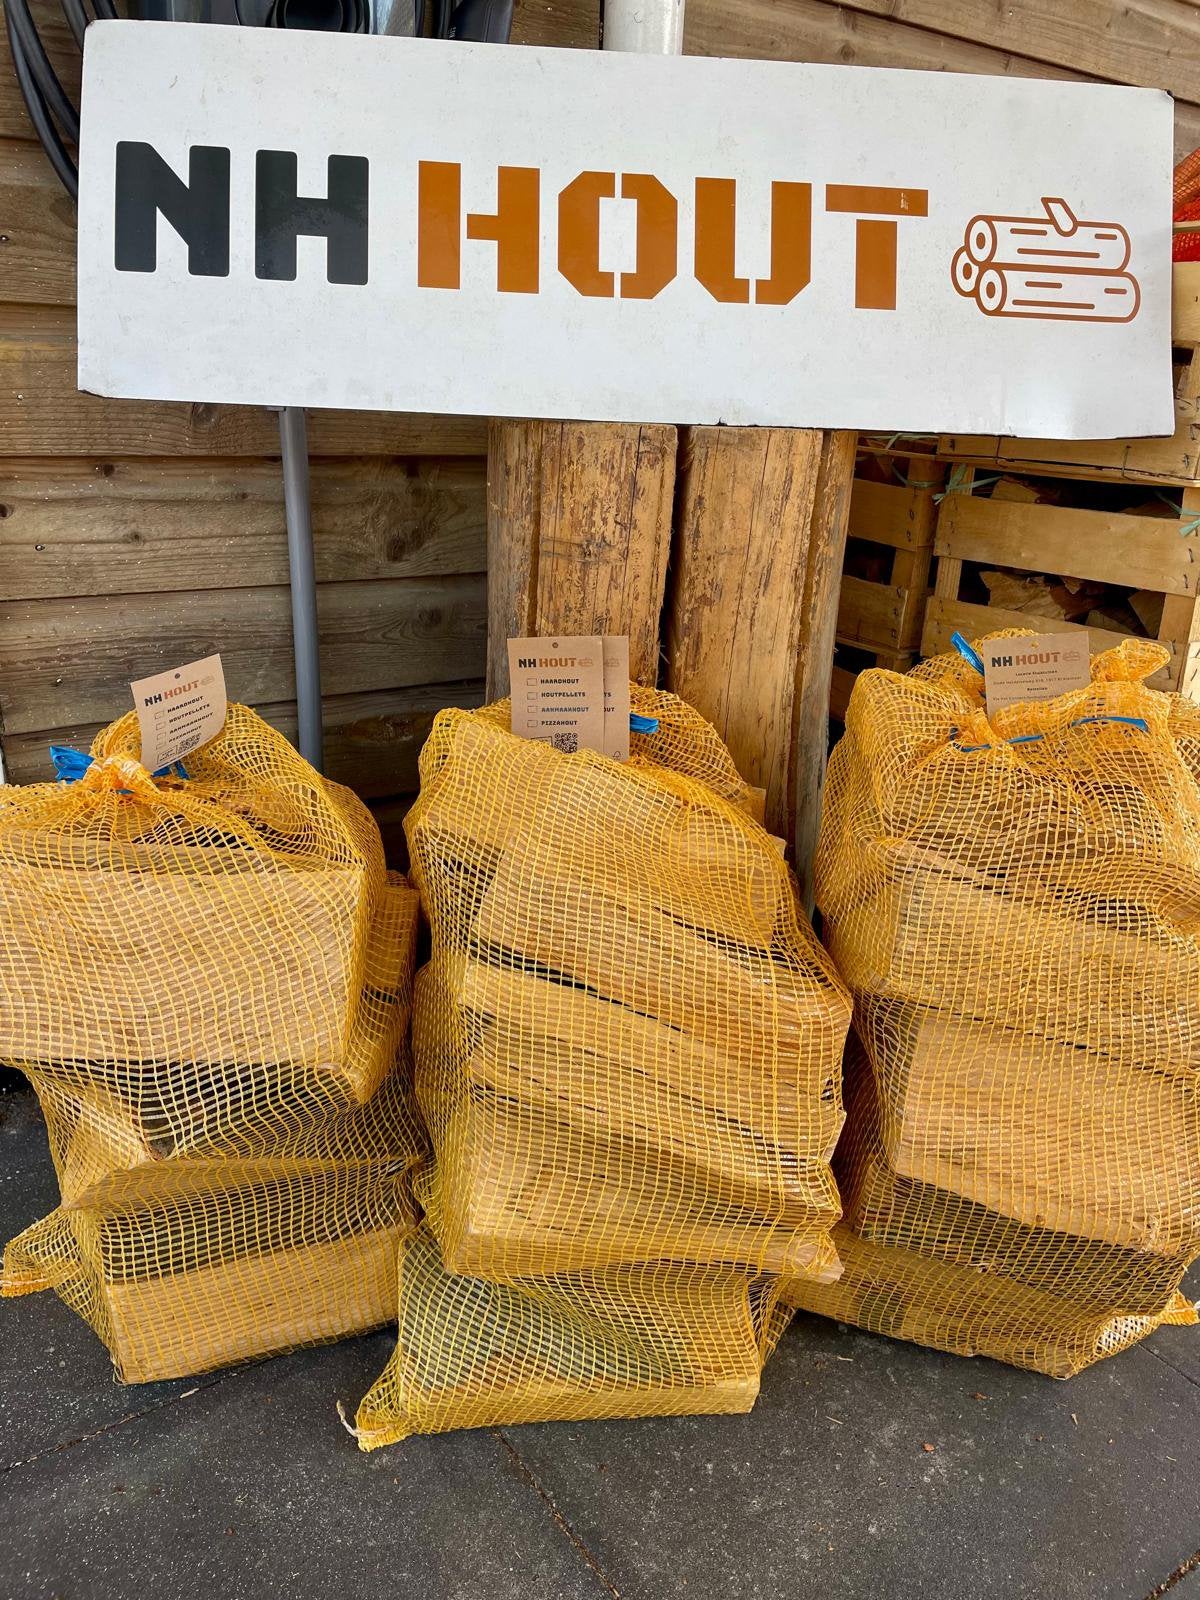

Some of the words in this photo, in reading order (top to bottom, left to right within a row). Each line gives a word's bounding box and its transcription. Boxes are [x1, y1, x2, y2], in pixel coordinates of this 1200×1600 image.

[115, 141, 369, 285] NH
[417, 160, 929, 311] HOUT
[518, 658, 537, 668] NH
[539, 657, 577, 668] HOUT
[991, 655, 1013, 668] NH
[1015, 652, 1061, 666] HOUT
[144, 693, 163, 707] NH
[164, 679, 200, 700] HOUT
[167, 695, 204, 714] HAARDHOUT
[169, 703, 211, 724] HOUTPELLETS
